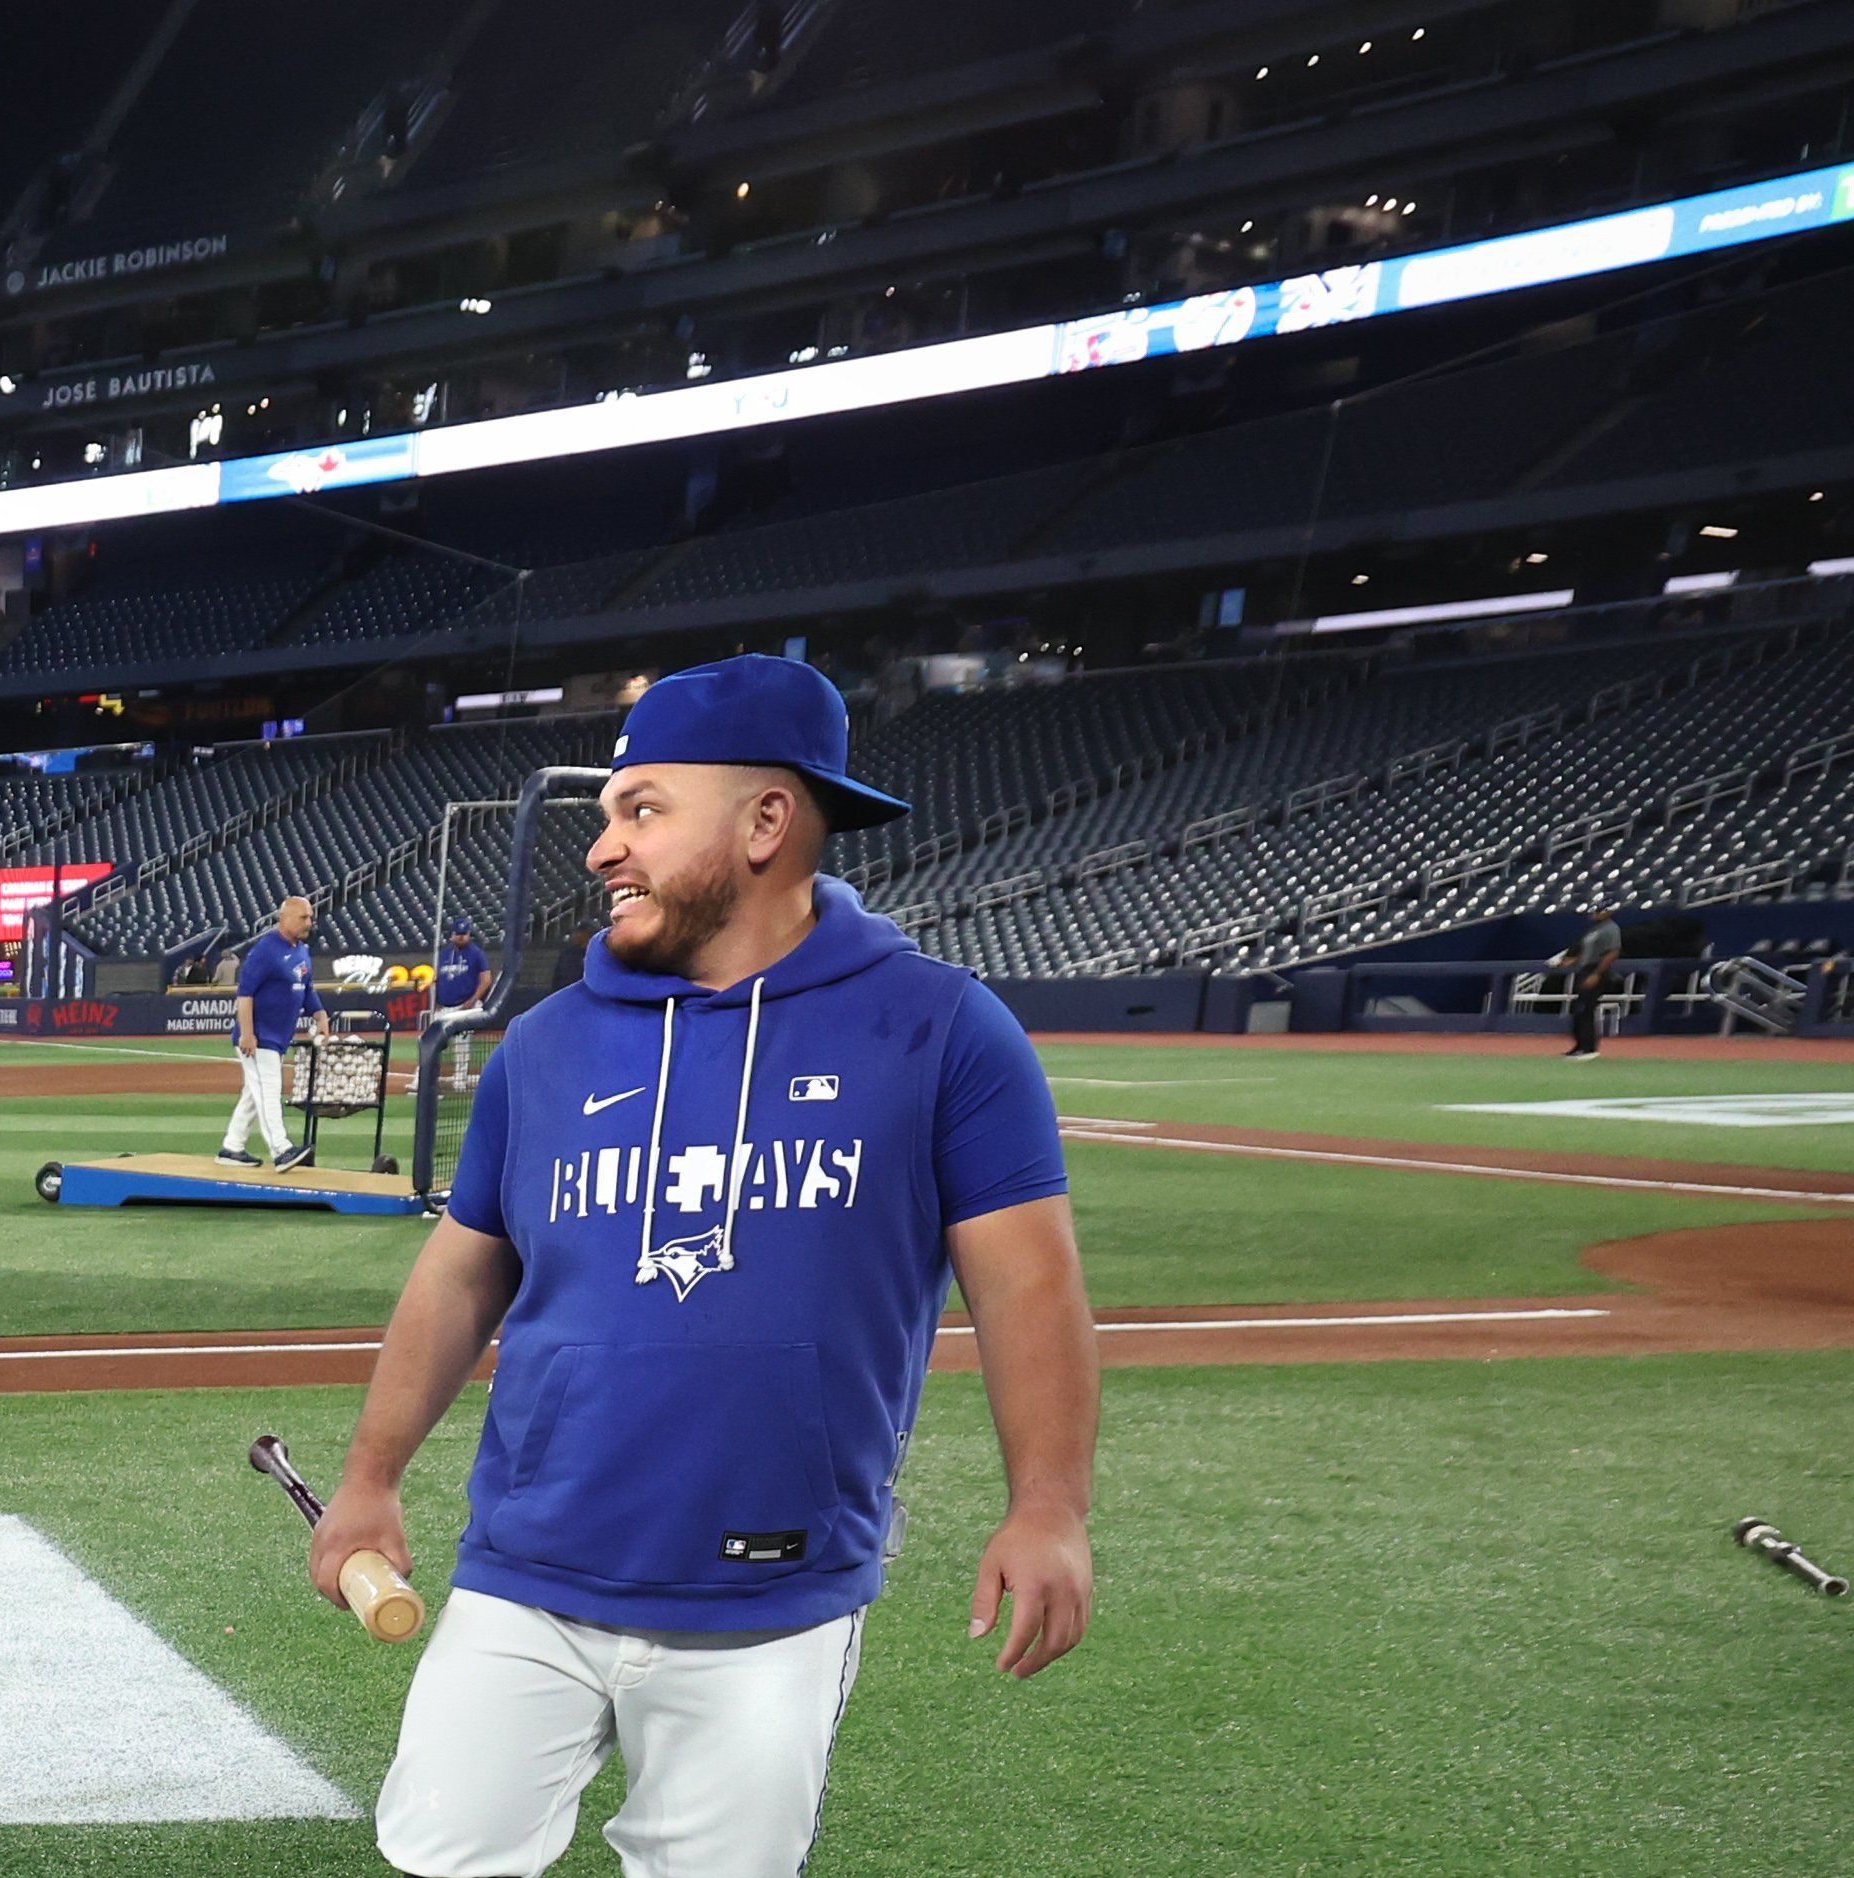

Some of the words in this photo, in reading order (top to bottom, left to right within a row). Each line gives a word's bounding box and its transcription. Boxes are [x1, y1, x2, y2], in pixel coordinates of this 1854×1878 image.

[37, 257, 107, 288] JACKIE
[113, 235, 228, 274] ROBINSON
[107, 362, 215, 397] BAUTISTA
[52, 1001, 120, 1029] HEINZ
[181, 999, 239, 1016] CANADIA
[166, 1018, 194, 1032] MADE
[195, 1017, 222, 1031] WITH
